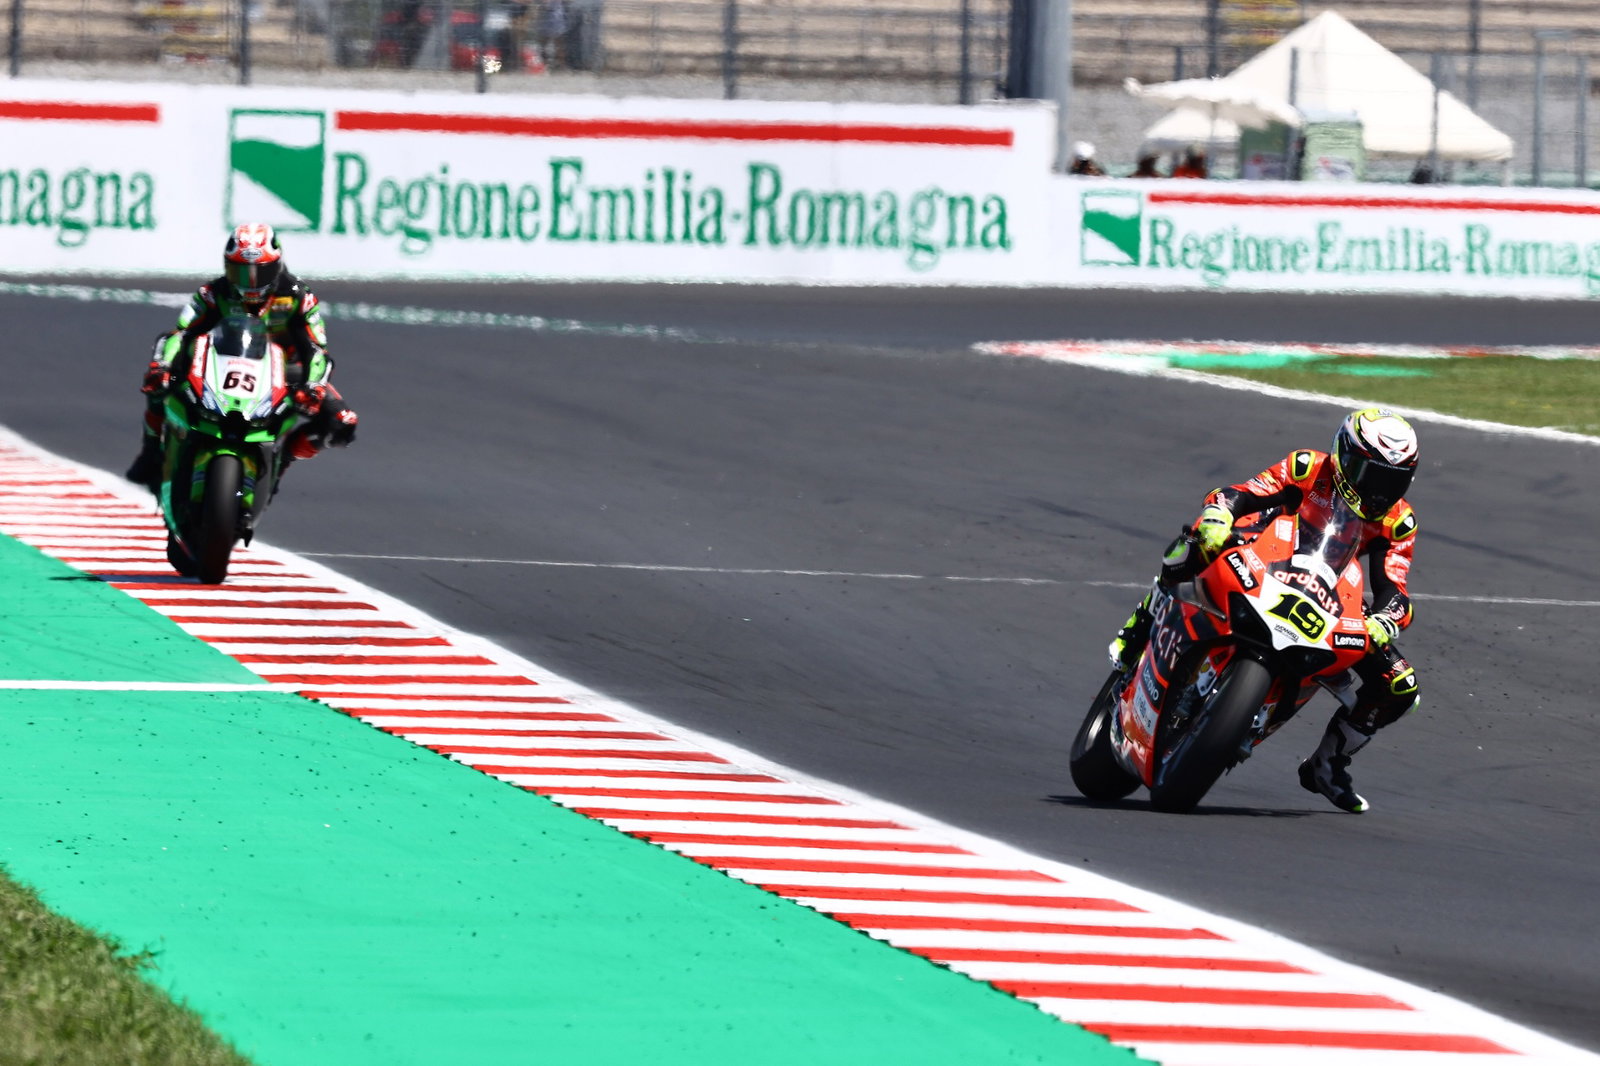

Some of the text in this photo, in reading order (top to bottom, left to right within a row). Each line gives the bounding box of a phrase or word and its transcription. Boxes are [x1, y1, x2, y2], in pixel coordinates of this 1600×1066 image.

[222, 371, 257, 392] 65
[1227, 552, 1254, 588] Lenovo
[1265, 593, 1326, 643] 19
[1334, 634, 1366, 648] Lenovo
